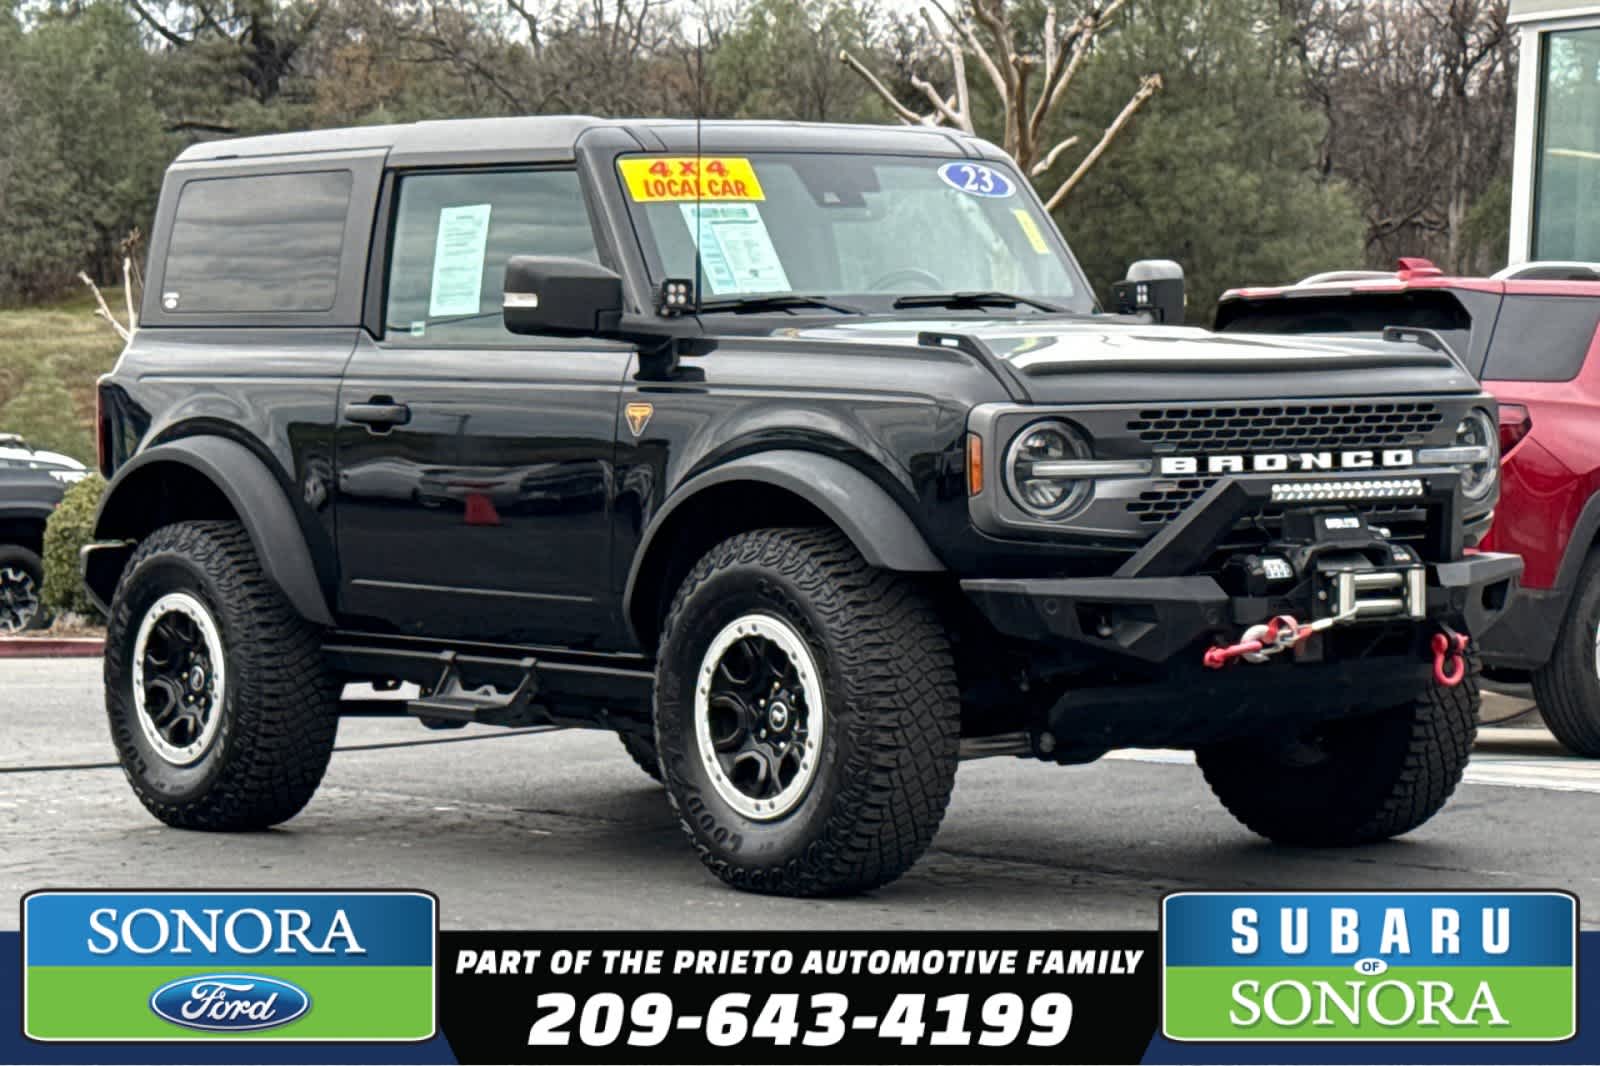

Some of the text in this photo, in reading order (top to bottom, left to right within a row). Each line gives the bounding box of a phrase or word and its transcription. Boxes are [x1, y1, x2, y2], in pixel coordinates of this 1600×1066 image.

[643, 179, 749, 197] LOCAL CAR
[960, 166, 994, 193] 23
[1160, 449, 1414, 474] BRONCO
